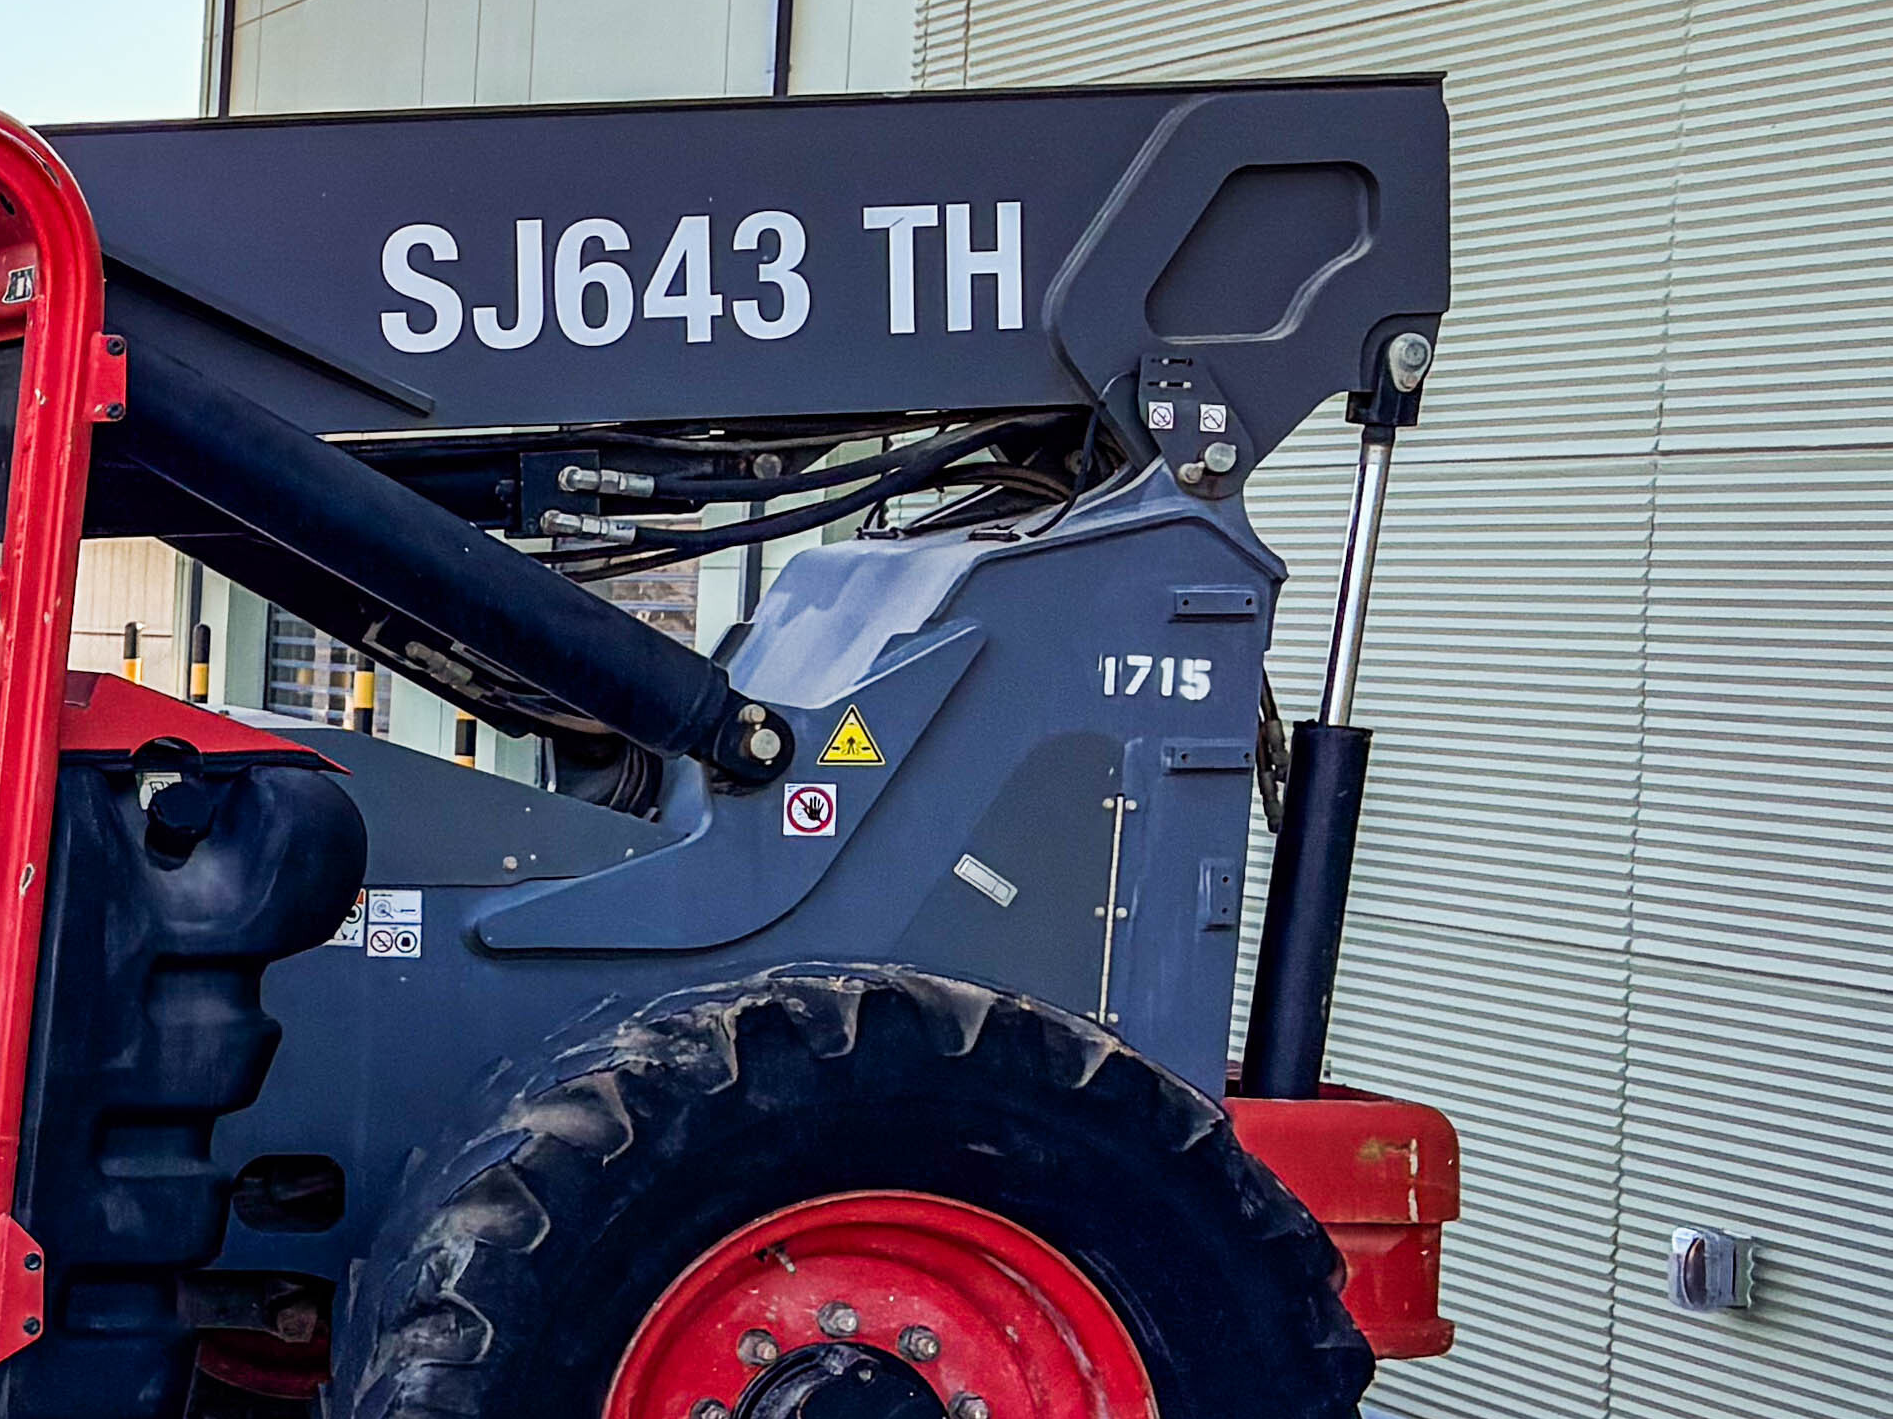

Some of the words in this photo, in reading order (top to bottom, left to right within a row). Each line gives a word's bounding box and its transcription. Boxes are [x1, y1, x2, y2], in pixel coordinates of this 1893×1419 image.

[380, 209, 811, 353] SJ643
[862, 201, 1023, 334] TH
[1102, 655, 1212, 700] 1715
